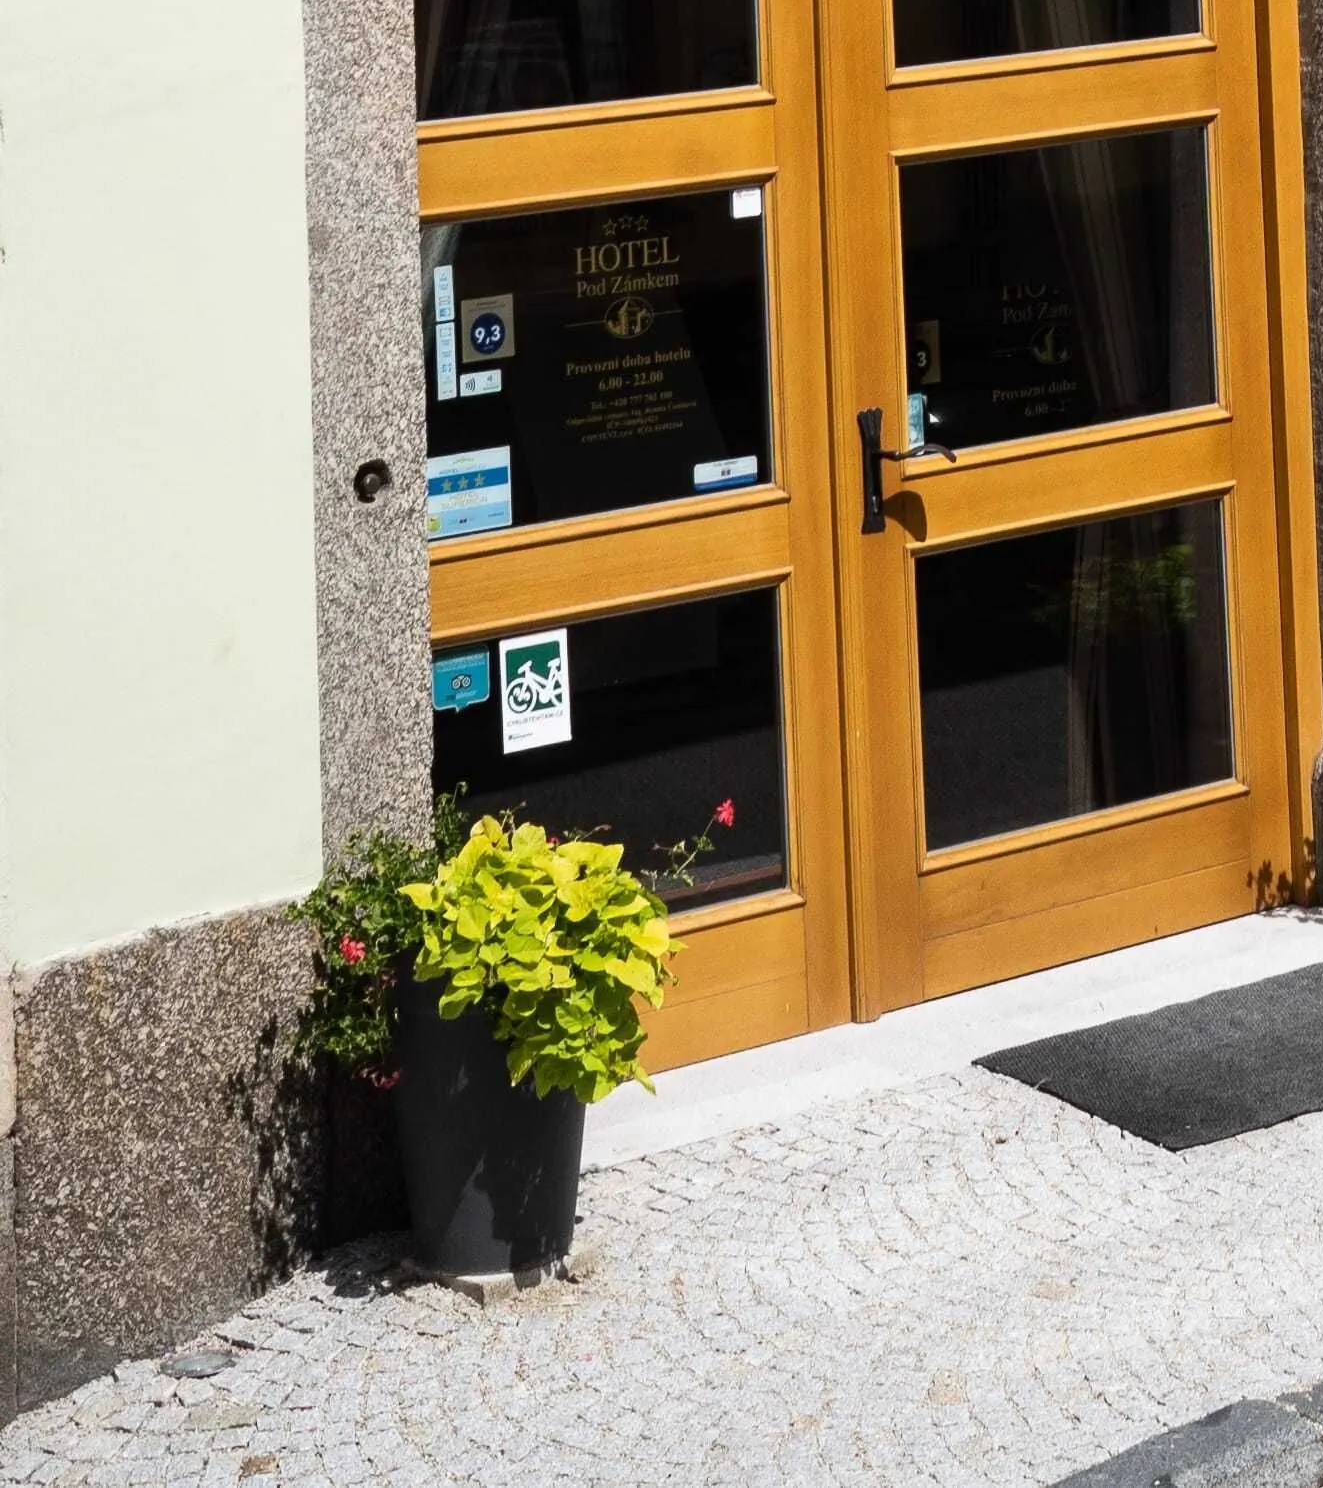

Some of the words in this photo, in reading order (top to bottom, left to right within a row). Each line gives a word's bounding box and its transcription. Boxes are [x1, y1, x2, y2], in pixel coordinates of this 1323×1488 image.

[573, 236, 680, 275] HOTEL
[576, 279, 606, 298] Pod
[611, 272, 680, 295] Zámkem
[474, 329, 502, 350] 9,3
[622, 353, 652, 368] doba
